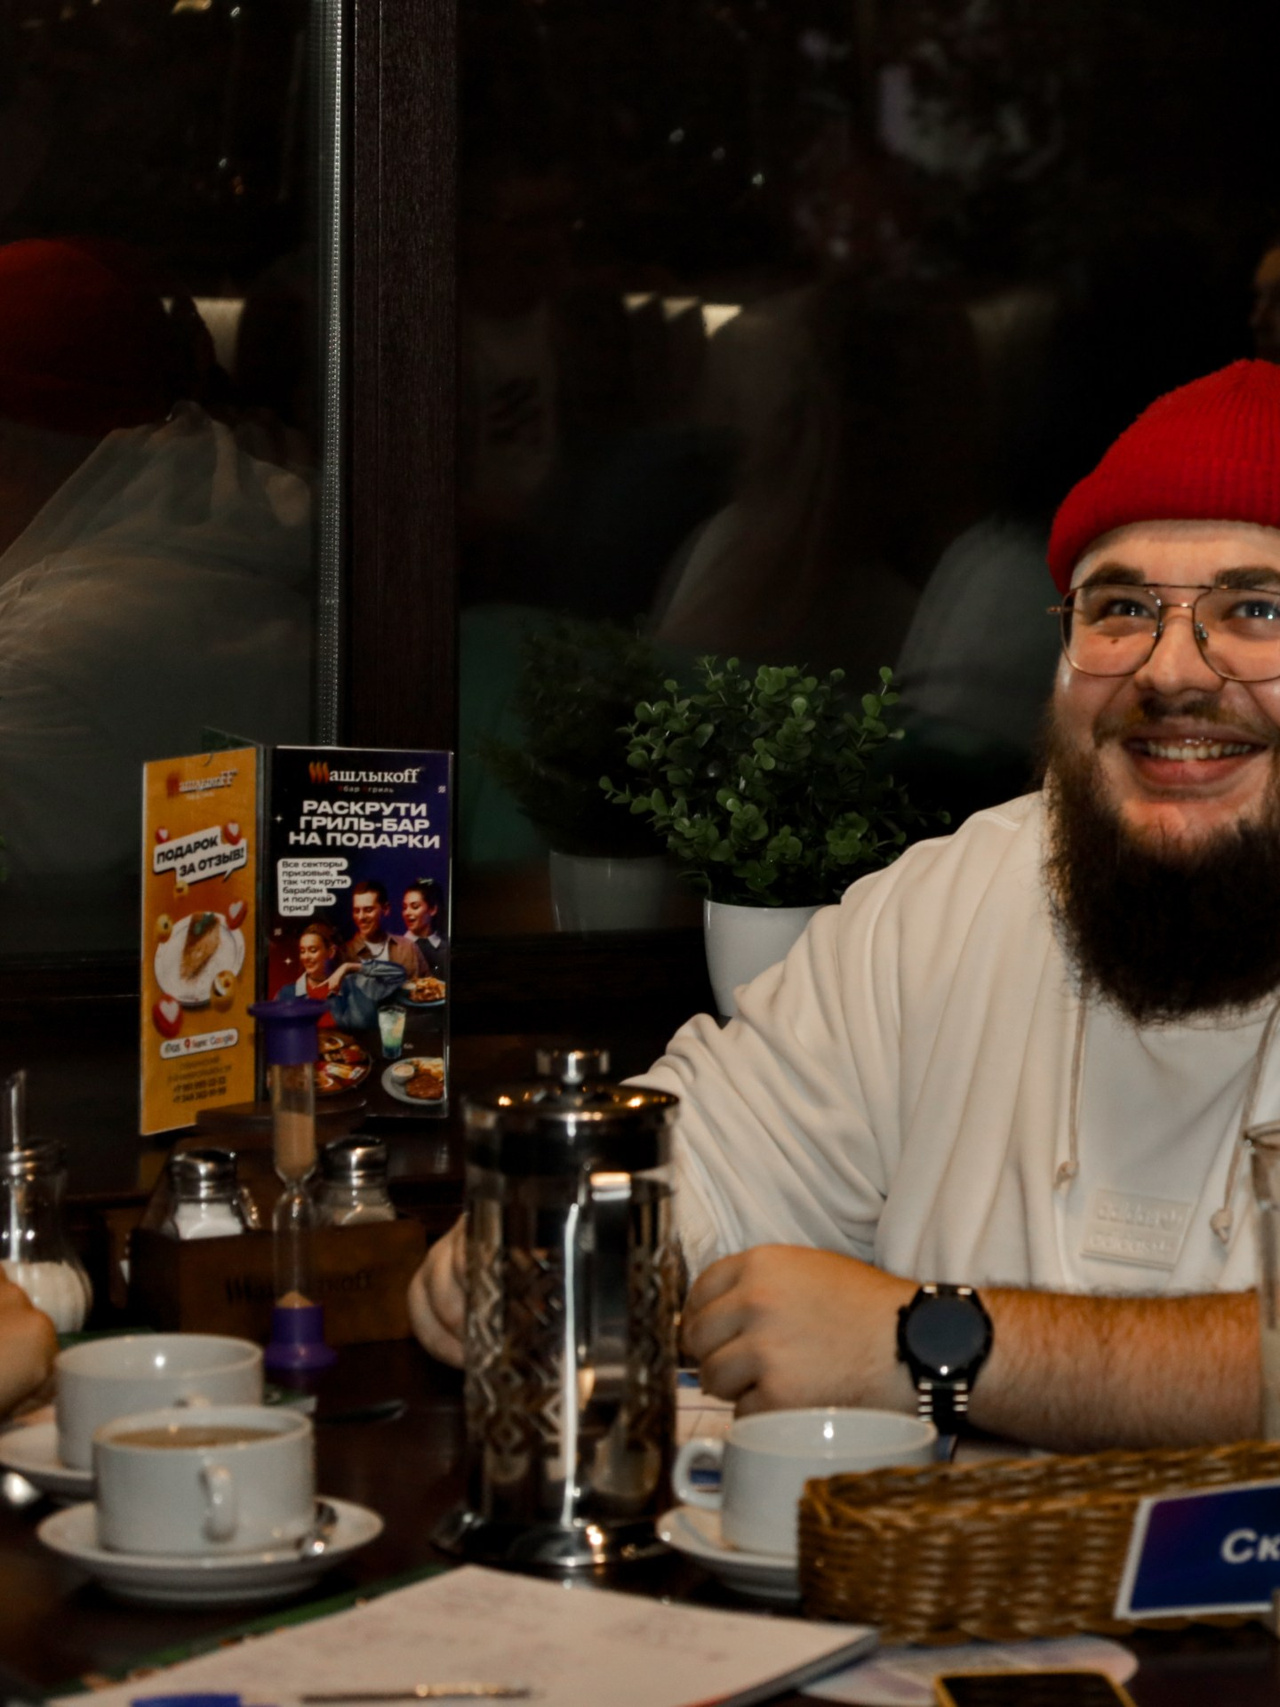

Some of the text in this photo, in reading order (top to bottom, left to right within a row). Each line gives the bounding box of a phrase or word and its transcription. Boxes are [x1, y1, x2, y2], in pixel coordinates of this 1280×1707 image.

[302, 800, 427, 817] РАСКРУТИ
[299, 815, 430, 832] ГРИЛЬ-БАР
[289, 831, 440, 849] НА ПОДАРКИ
[157, 835, 218, 864] ПОДАРОК
[179, 847, 244, 877] ЗА ОТЗЫВ!
[302, 861, 343, 869] секторы
[282, 870, 333, 878] призовые,
[319, 879, 347, 887] крути
[283, 887, 323, 895] барабан
[292, 895, 332, 904] получай
[283, 904, 309, 912] приз!
